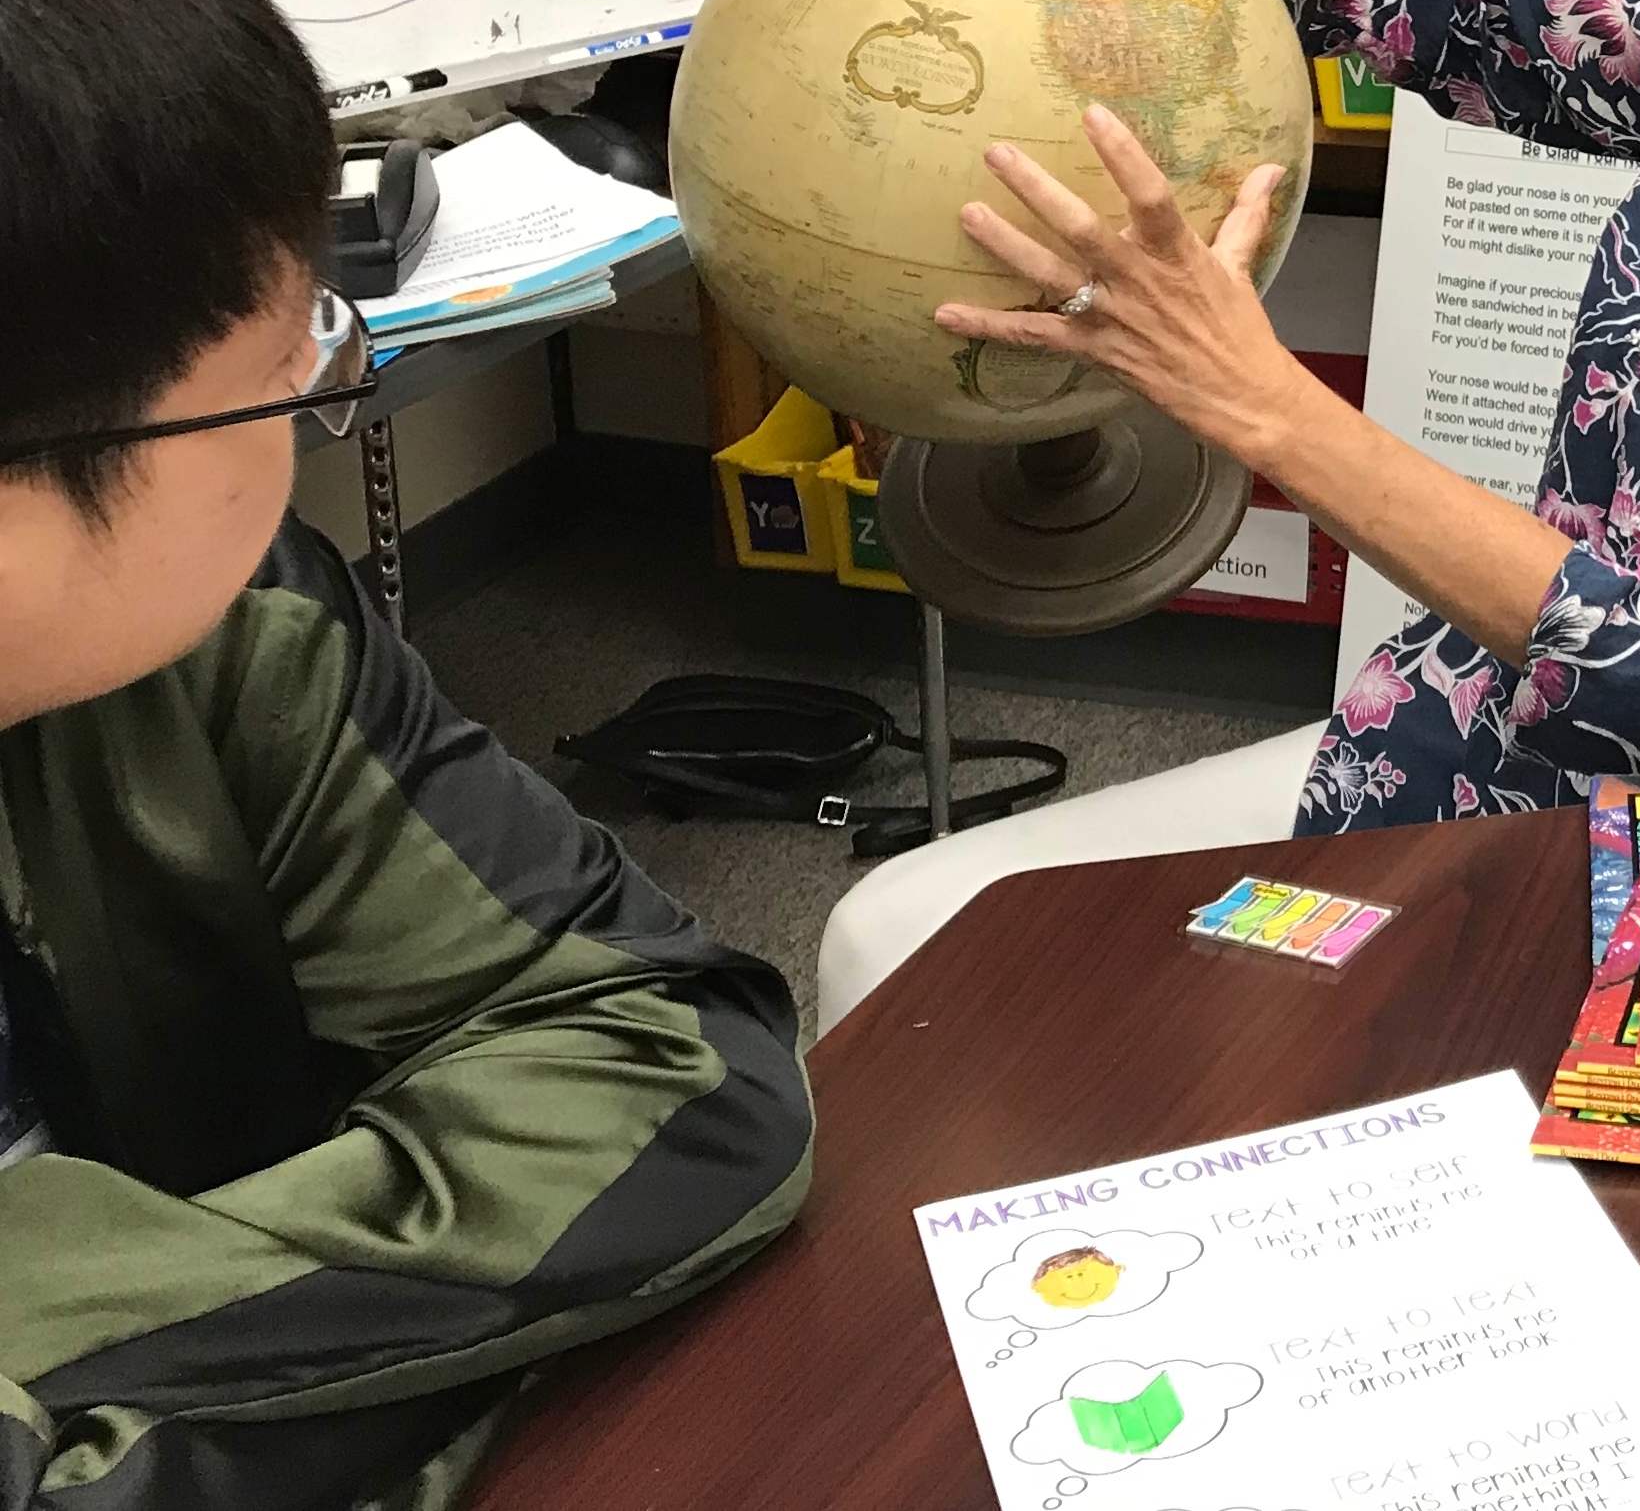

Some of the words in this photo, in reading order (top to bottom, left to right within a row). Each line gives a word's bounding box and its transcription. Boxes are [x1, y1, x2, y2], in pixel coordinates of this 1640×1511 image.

[1345, 58, 1366, 86] V
[1522, 140, 1541, 156] Be
[1447, 176, 1464, 190] Be
[1467, 180, 1493, 194] glad
[1496, 185, 1524, 197] your
[1527, 188, 1557, 201] nose
[1560, 190, 1570, 202] is
[1574, 194, 1590, 204] on
[1593, 196, 1621, 209] your
[1445, 196, 1467, 211] Not
[1469, 201, 1511, 215] pasted
[1514, 207, 1529, 217] on
[1533, 209, 1567, 222] some
[1570, 212, 1603, 225] other
[1443, 215, 1464, 229] For
[1467, 218, 1475, 230] if
[1477, 219, 1485, 232] it
[1488, 223, 1518, 235] were
[1521, 225, 1559, 240] where
[1562, 229, 1570, 241] it
[1573, 230, 1583, 243] is
[1442, 234, 1466, 249] You
[1469, 239, 1503, 255] might
[1505, 242, 1544, 258] dislike
[1547, 249, 1575, 262] your
[1437, 273, 1486, 291] Imagine
[1489, 279, 1498, 291] if
[1500, 283, 1527, 295] your
[1529, 287, 1582, 302] precious
[1436, 291, 1468, 307] Were
[1472, 299, 1544, 317] sandwiched
[1547, 305, 1558, 318] in
[1434, 311, 1461, 327] That
[1464, 316, 1504, 334] clearly
[1507, 323, 1544, 337] would
[1547, 328, 1567, 340] not
[1428, 369, 1457, 384] Your
[1460, 376, 1490, 389] nose
[1493, 380, 1529, 394] would
[1532, 383, 1548, 397] be
[750, 501, 769, 528] Y
[856, 518, 877, 546] Z
[1211, 556, 1267, 579] ction
[928, 1177, 1119, 1237] MAKING
[1138, 1102, 1446, 1191] CONNECTIONS
[1329, 1180, 1372, 1206] to
[1386, 1307, 1431, 1334] to
[1382, 1321, 1504, 1365] reminds
[1514, 1306, 1557, 1331] me
[1299, 1389, 1332, 1409] of
[1349, 1351, 1474, 1395] another
[1488, 1331, 1559, 1360] book
